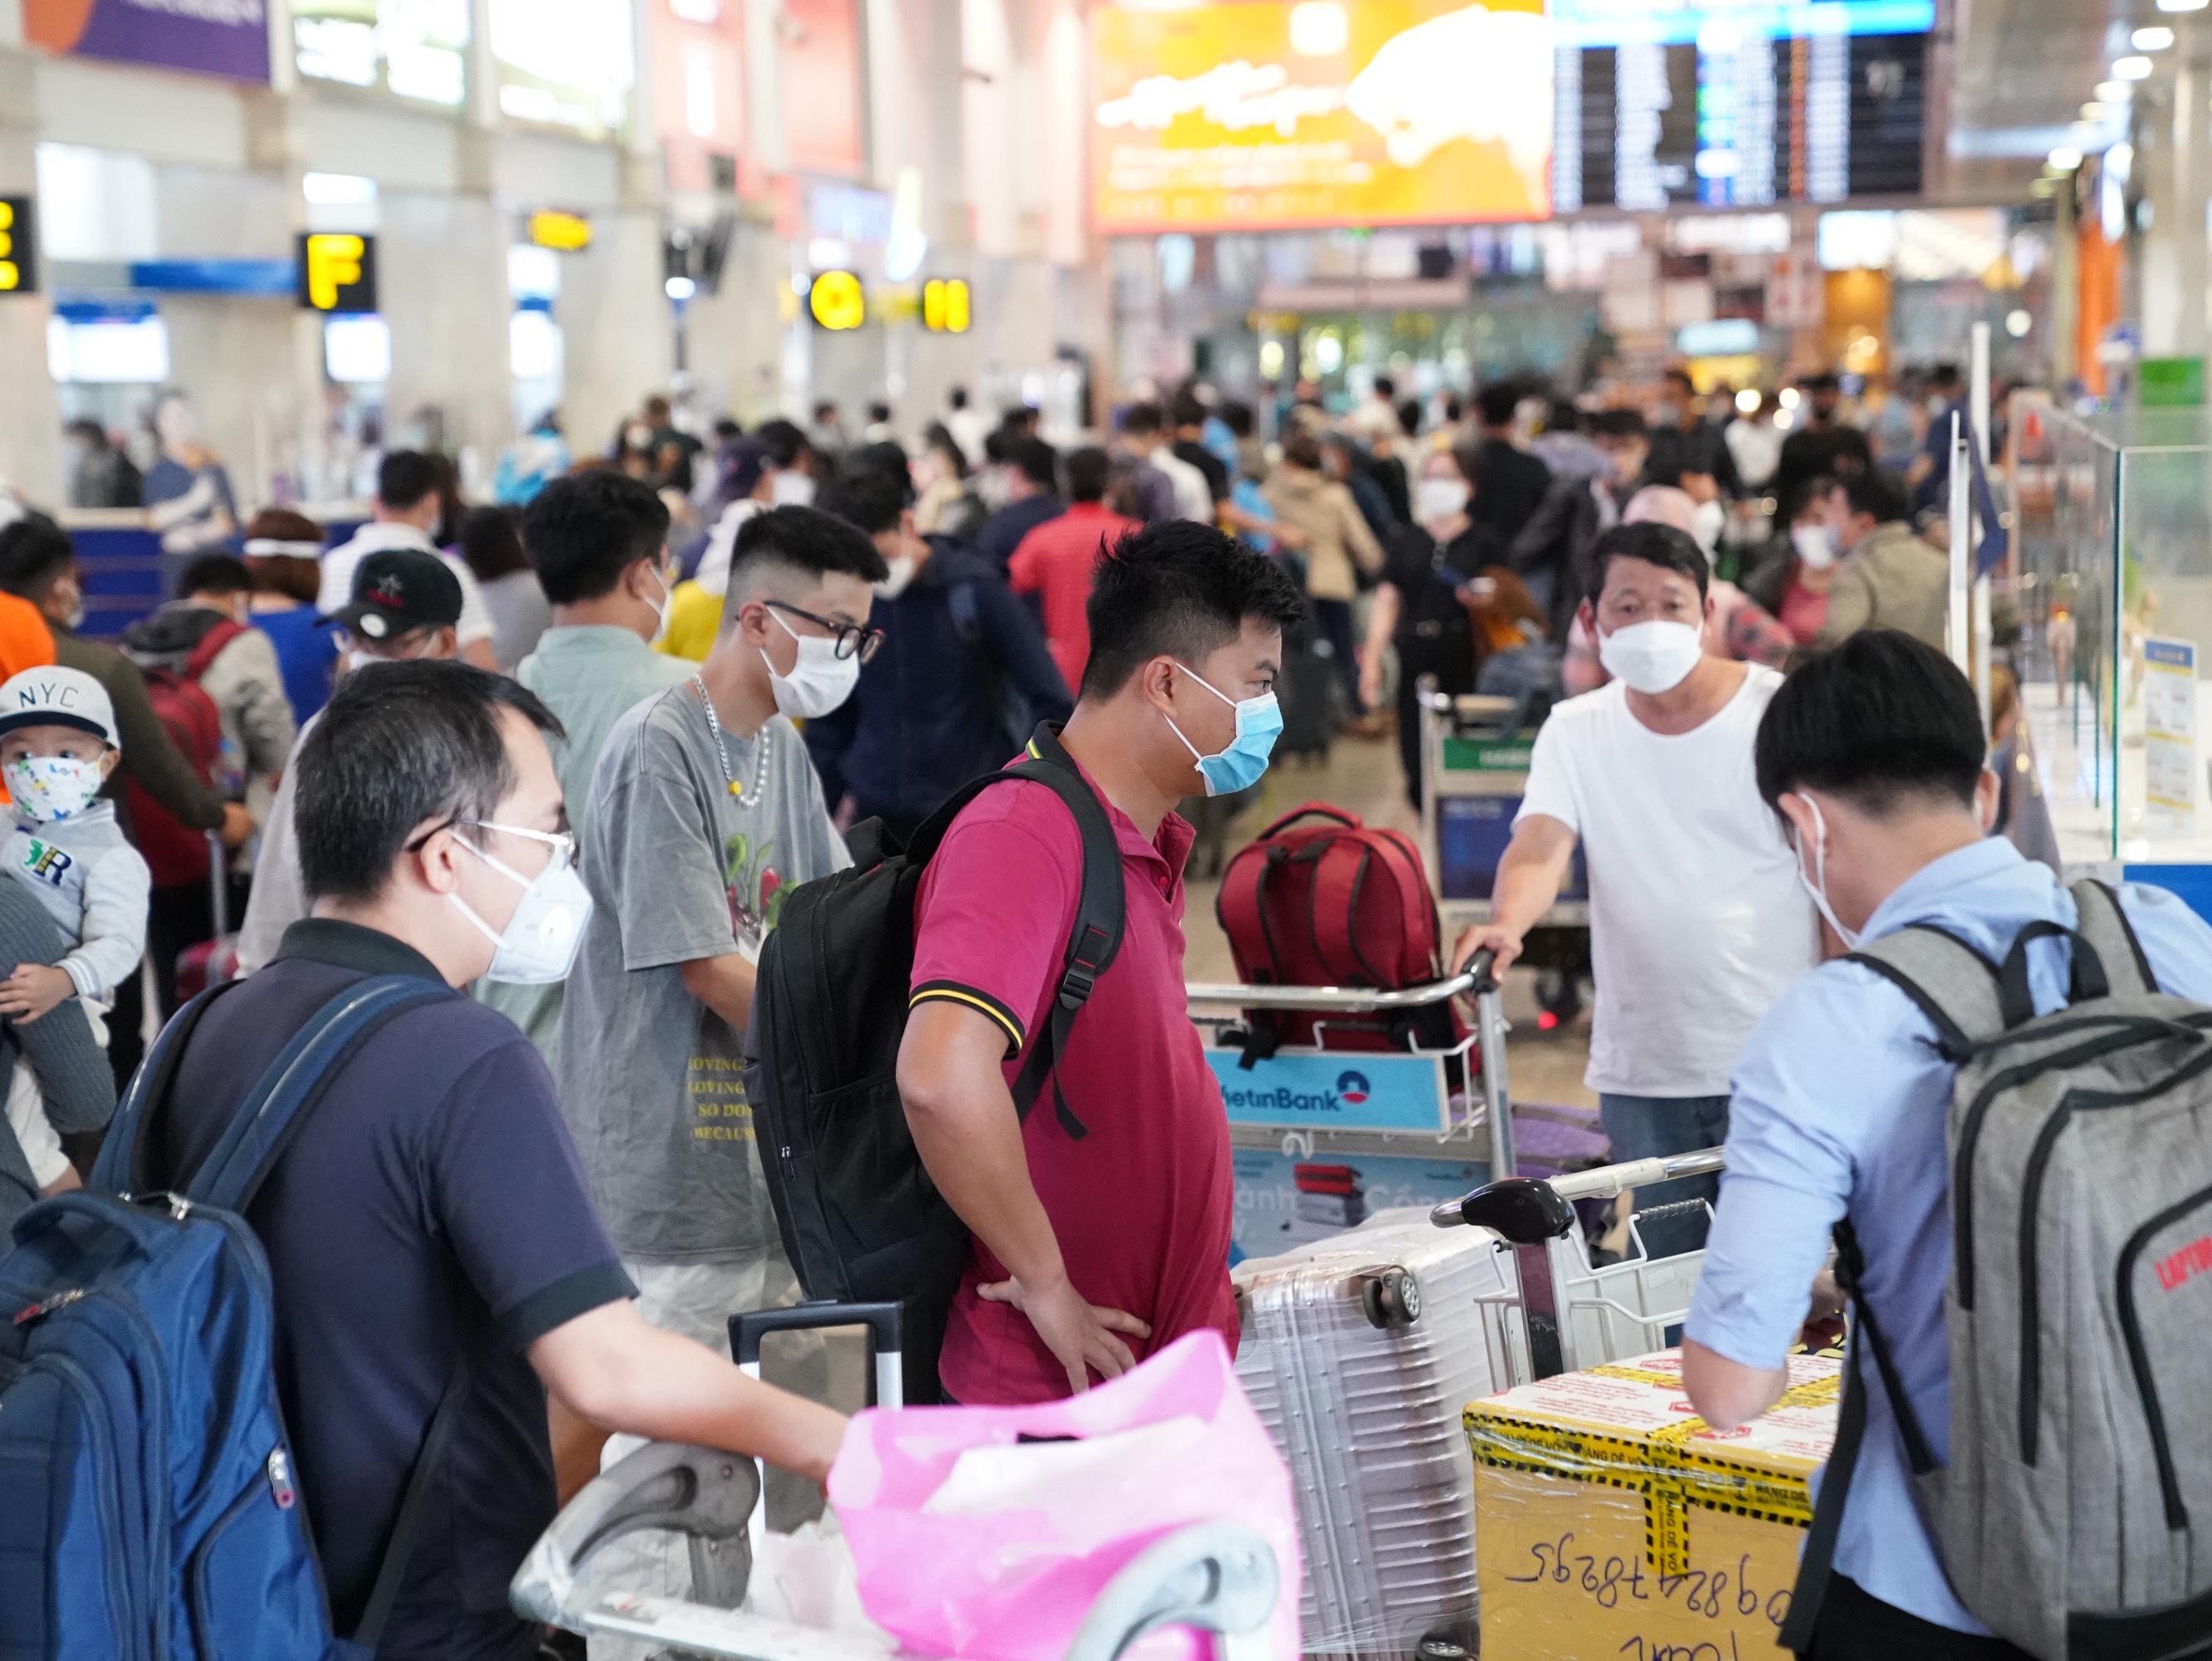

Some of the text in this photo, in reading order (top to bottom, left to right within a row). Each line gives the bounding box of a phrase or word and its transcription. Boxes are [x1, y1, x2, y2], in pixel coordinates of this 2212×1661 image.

[306, 233, 365, 310] F
[18, 682, 79, 709] NYC
[698, 1103, 719, 1117] SO
